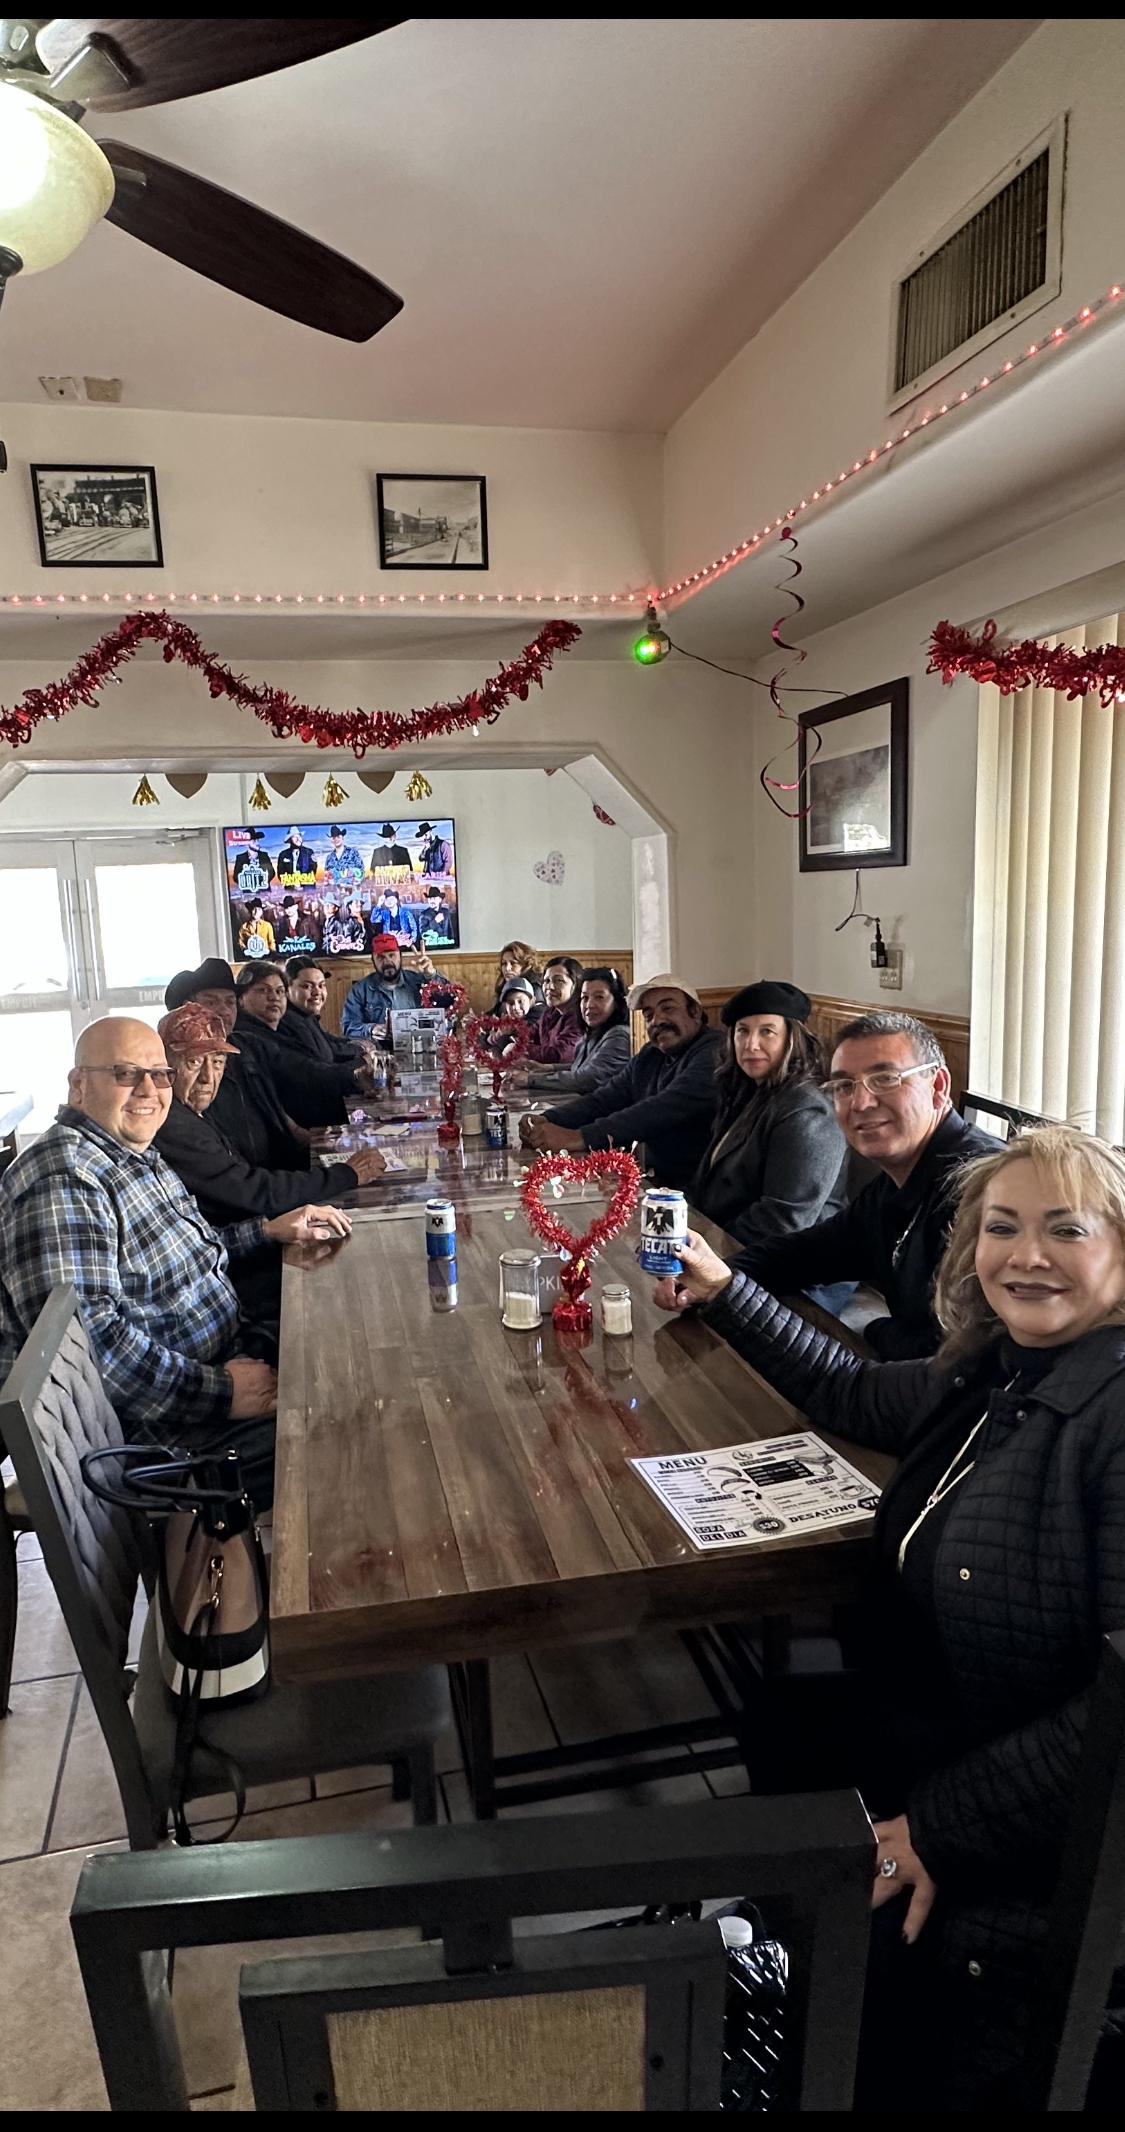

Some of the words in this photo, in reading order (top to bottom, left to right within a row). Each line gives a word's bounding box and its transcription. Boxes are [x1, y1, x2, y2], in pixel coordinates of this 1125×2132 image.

[139, 990, 165, 1003] EMPU
[658, 1456, 708, 1470] MENU
[788, 1504, 857, 1523] DESAYUNO
[696, 1525, 724, 1533] SOPA
[759, 1521, 779, 1531] $30
[702, 1533, 724, 1541] DEL
[726, 1531, 747, 1539] DIA
